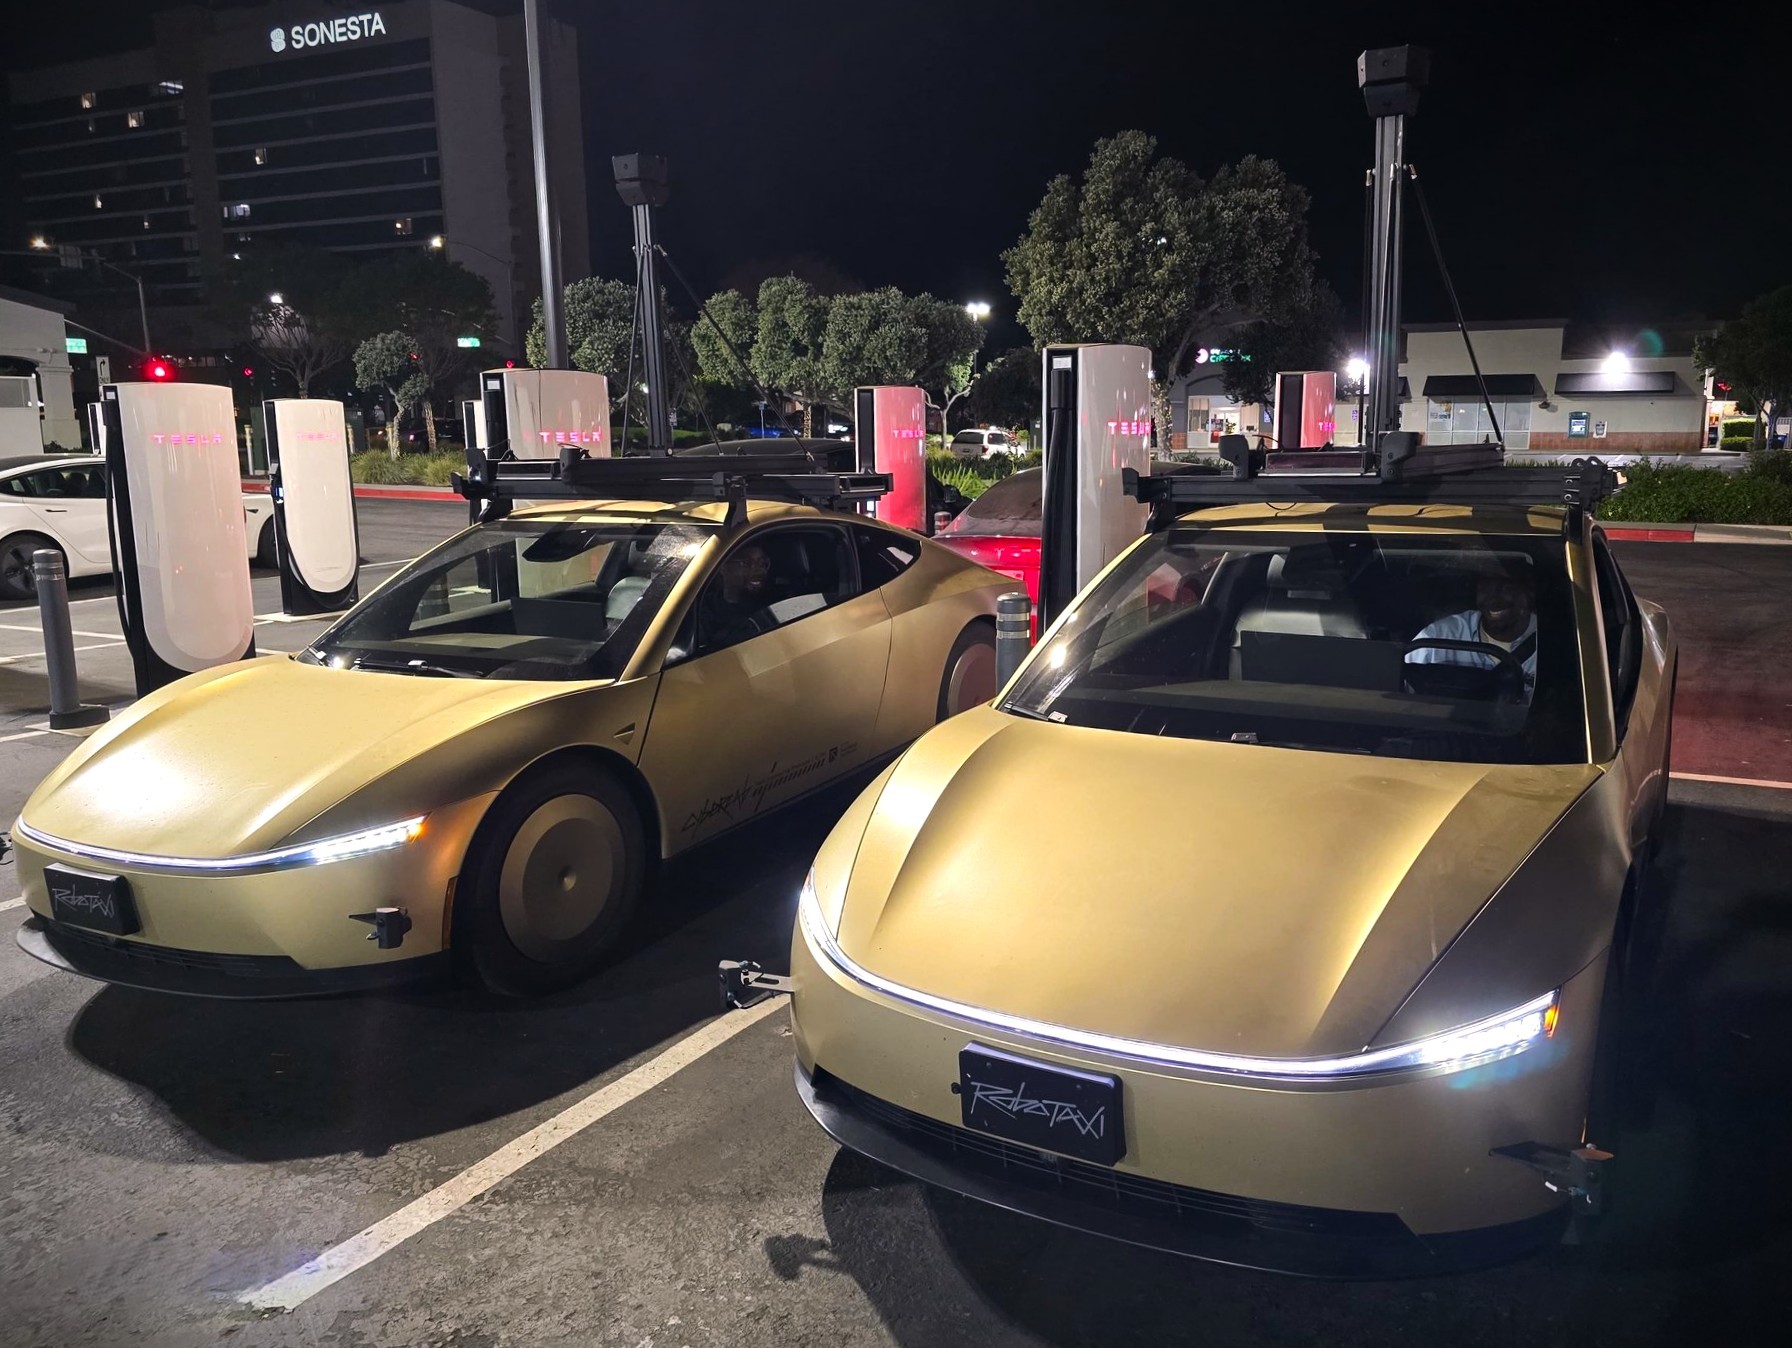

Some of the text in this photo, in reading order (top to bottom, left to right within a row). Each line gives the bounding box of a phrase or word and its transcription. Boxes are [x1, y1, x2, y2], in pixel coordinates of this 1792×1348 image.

[291, 12, 386, 49] SONESTA
[152, 434, 223, 445] TESLA
[539, 430, 600, 442] TESLA
